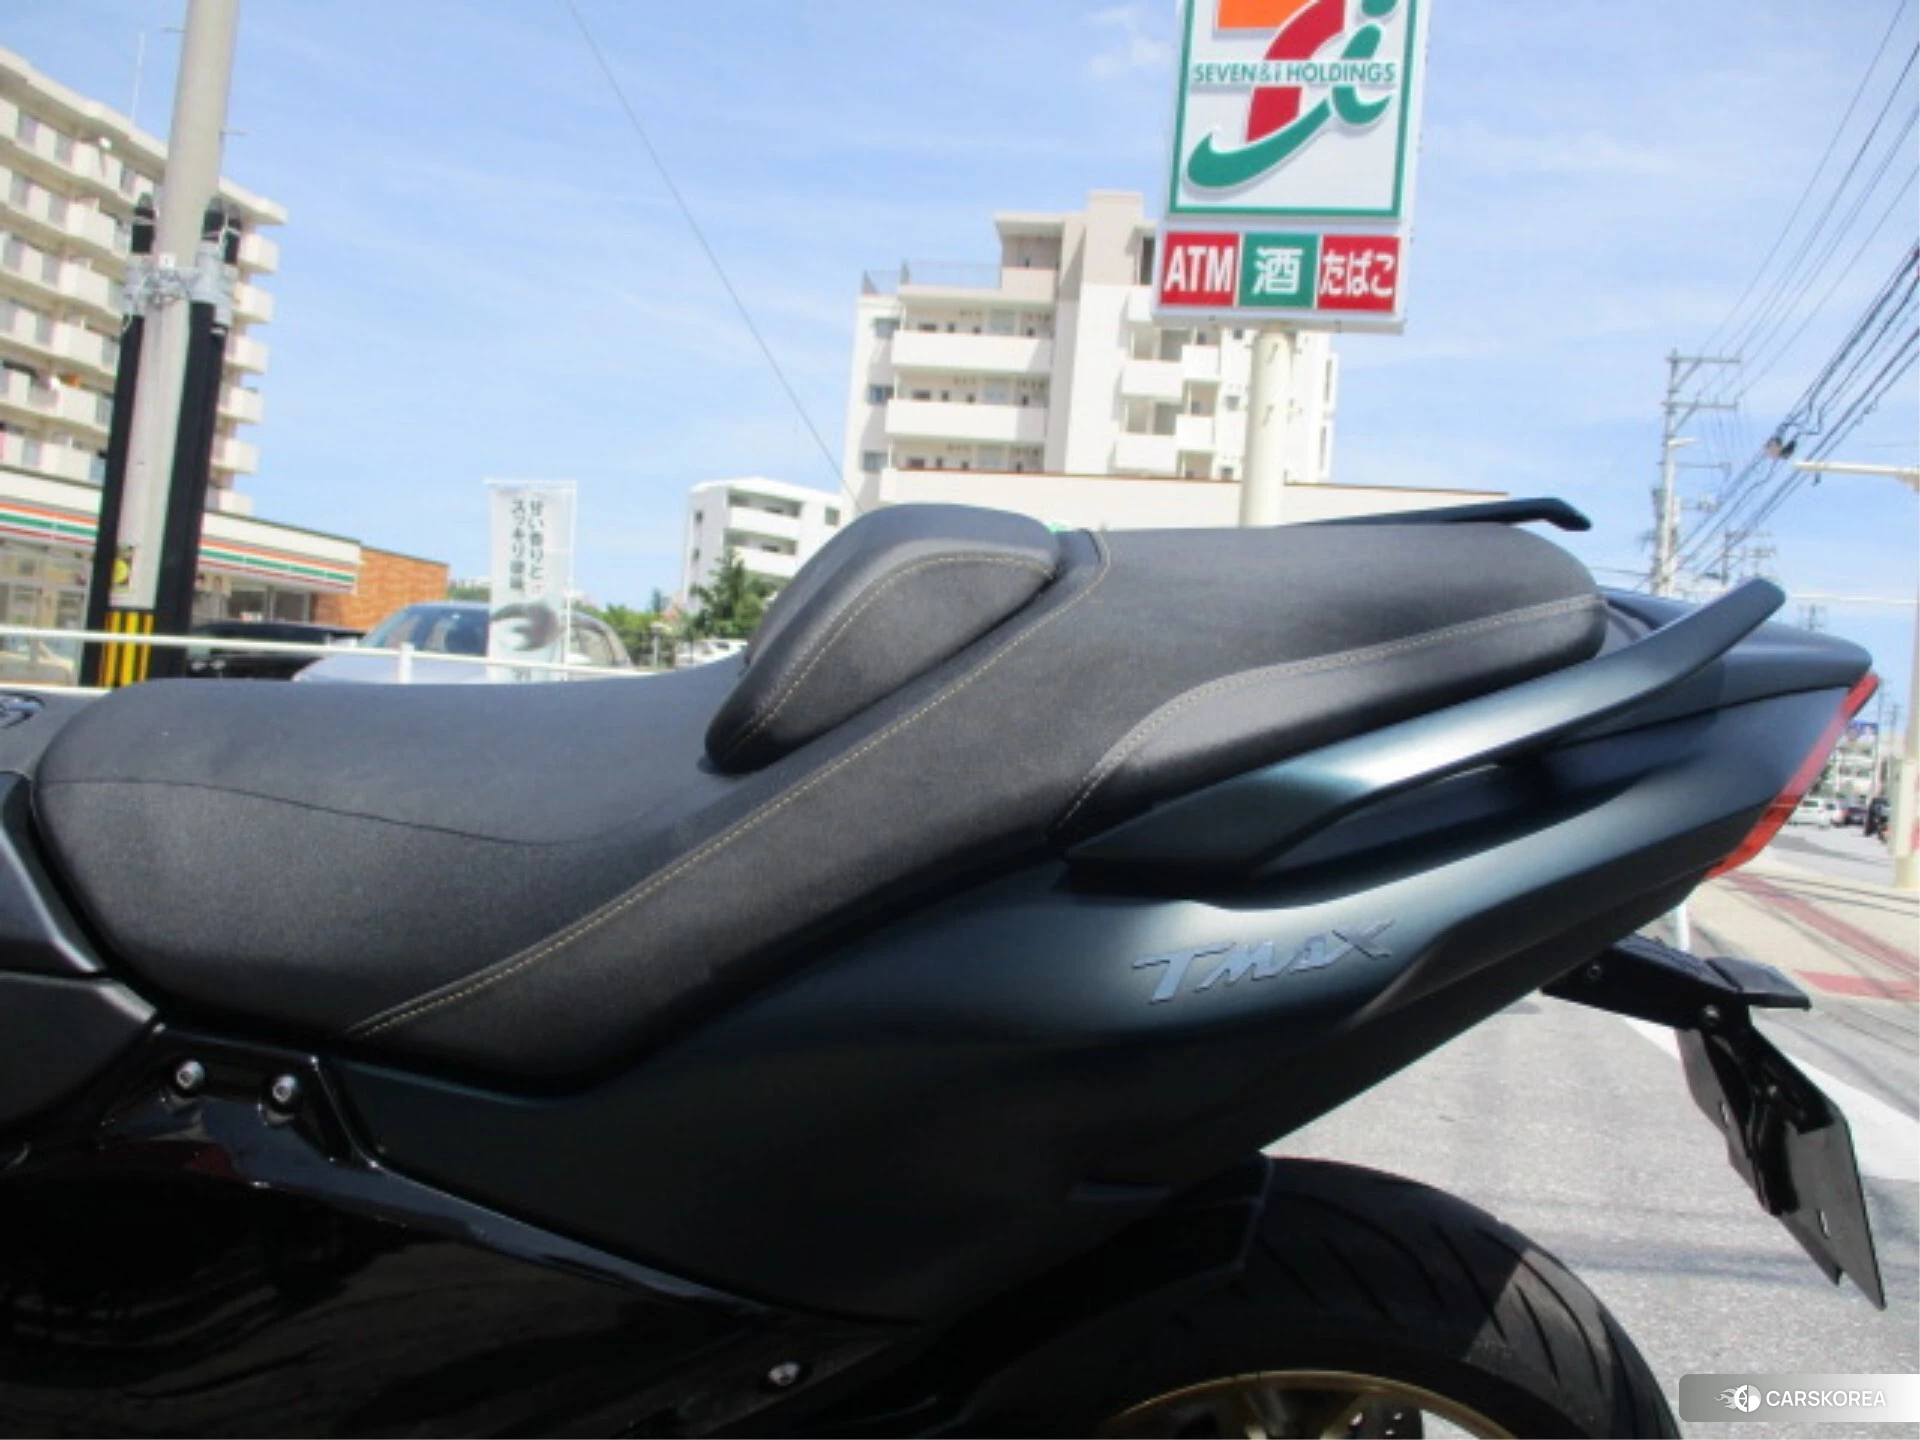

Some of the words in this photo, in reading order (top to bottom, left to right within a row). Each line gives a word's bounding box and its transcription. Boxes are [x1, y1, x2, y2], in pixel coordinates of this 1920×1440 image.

[1286, 62, 1396, 83] HOLDINGS
[1163, 245, 1235, 294] ATM
[1252, 246, 1304, 296] 酒
[1319, 248, 1395, 298] たばこ
[1131, 919, 1396, 1005] TMAX
